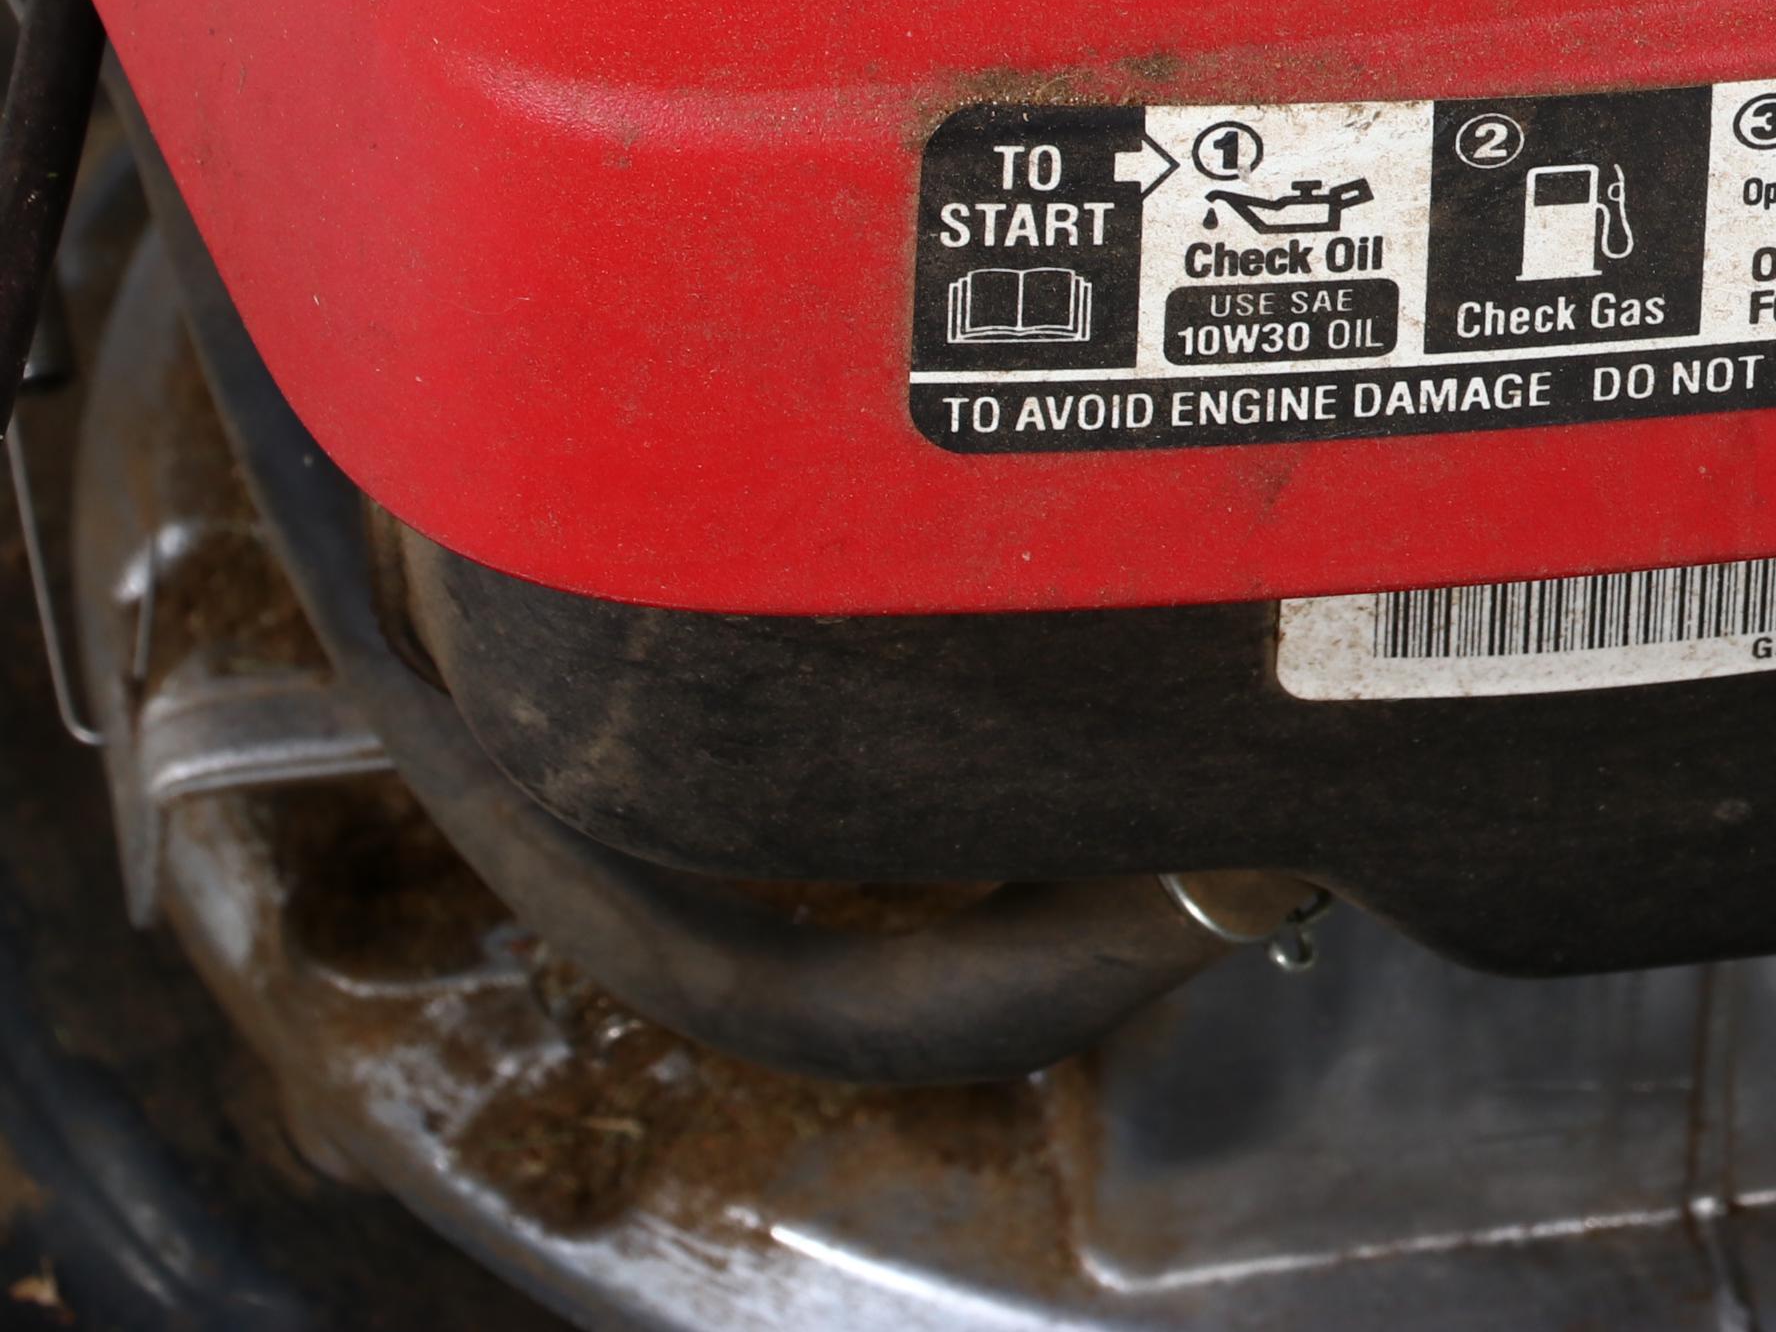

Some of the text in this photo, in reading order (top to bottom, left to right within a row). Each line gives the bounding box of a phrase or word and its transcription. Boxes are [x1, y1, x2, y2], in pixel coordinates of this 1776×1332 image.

[993, 145, 1062, 191] TO
[939, 203, 1114, 248] START
[1184, 236, 1383, 280] Check Oil
[1209, 290, 1353, 318] USE SAE
[1456, 293, 1665, 338] Check Gas
[1178, 320, 1384, 356] 10W30 OIL
[944, 394, 1000, 433] TO
[1015, 391, 1153, 432] AVOID
[1171, 384, 1335, 427] ENGINE
[1353, 372, 1552, 416] DAMAGE
[1591, 366, 1655, 403] DO
[1672, 355, 1765, 395] NOT
